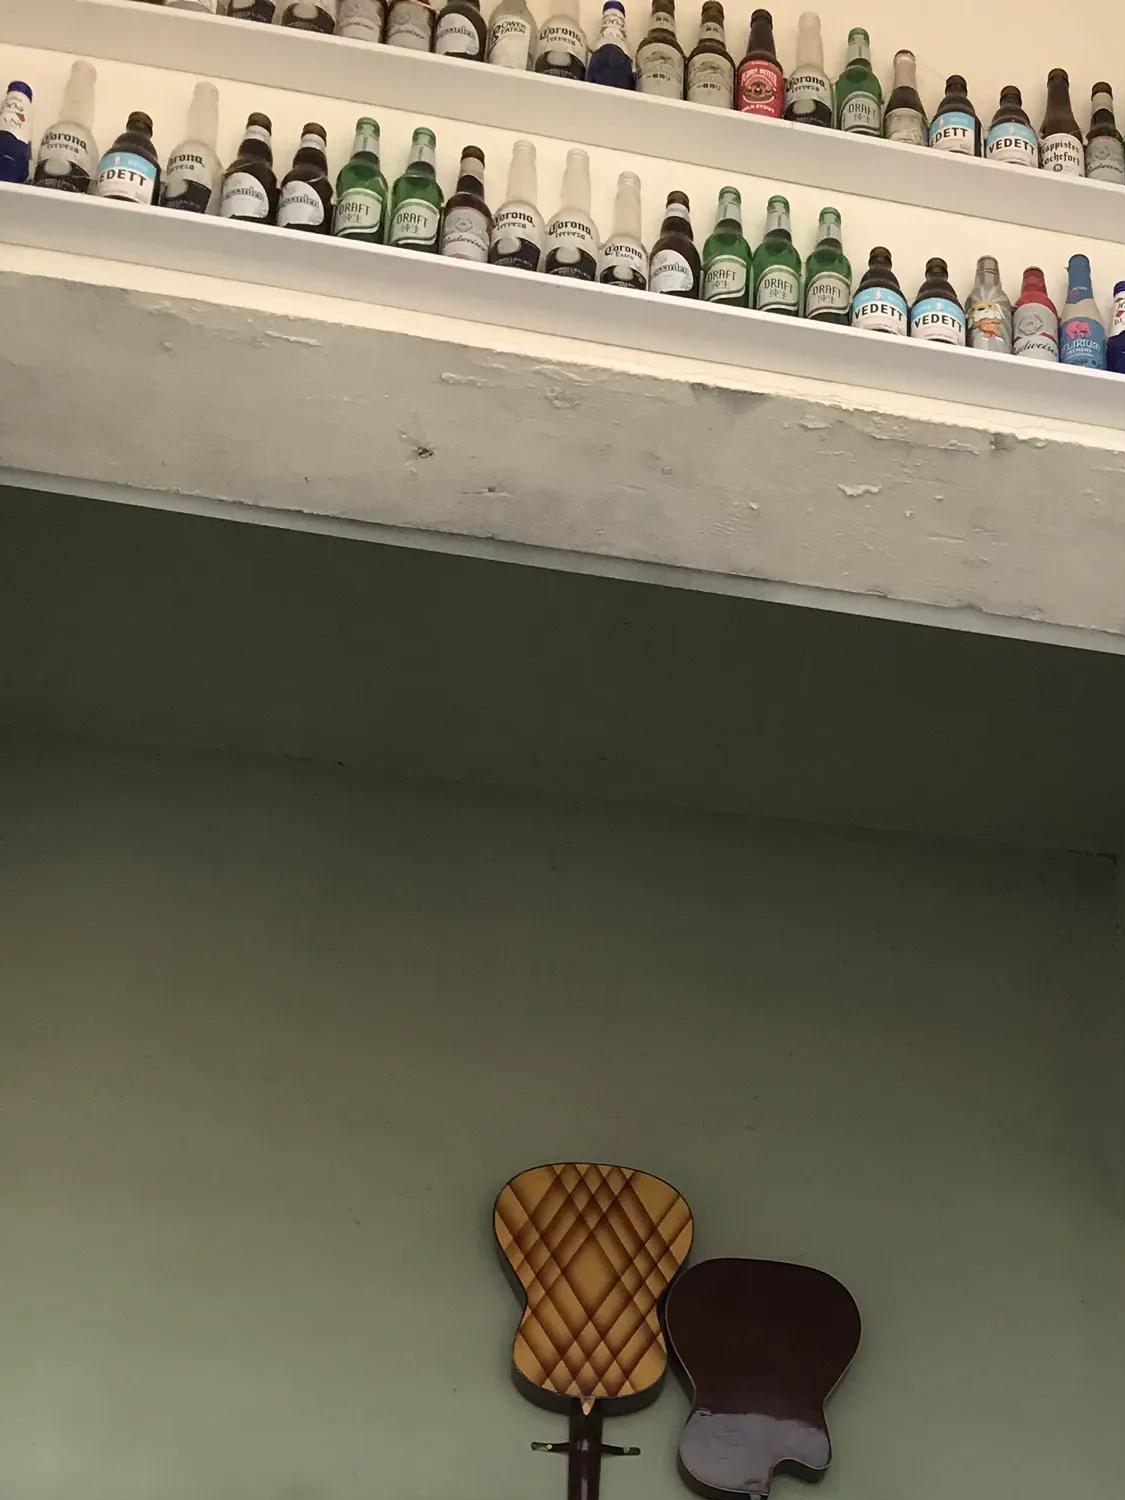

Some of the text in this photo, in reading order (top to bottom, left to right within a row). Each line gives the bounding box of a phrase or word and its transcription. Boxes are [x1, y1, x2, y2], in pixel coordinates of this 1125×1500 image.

[786, 74, 826, 93] Corona
[848, 103, 876, 117] DRAFT
[41, 131, 88, 152] Corona
[929, 126, 968, 148] EDETT
[989, 137, 1035, 154] VEDETT
[99, 169, 147, 187] EDETT
[338, 201, 370, 216] DRAFT
[396, 214, 428, 230] DRAFT
[549, 219, 593, 240] Corona
[604, 242, 643, 260] Corona
[706, 268, 737, 283] DRAFT
[763, 278, 794, 293] DRAFT
[812, 284, 841, 298] DRAFT
[854, 302, 903, 322] VEDETT
[914, 312, 962, 333] VEDETT
